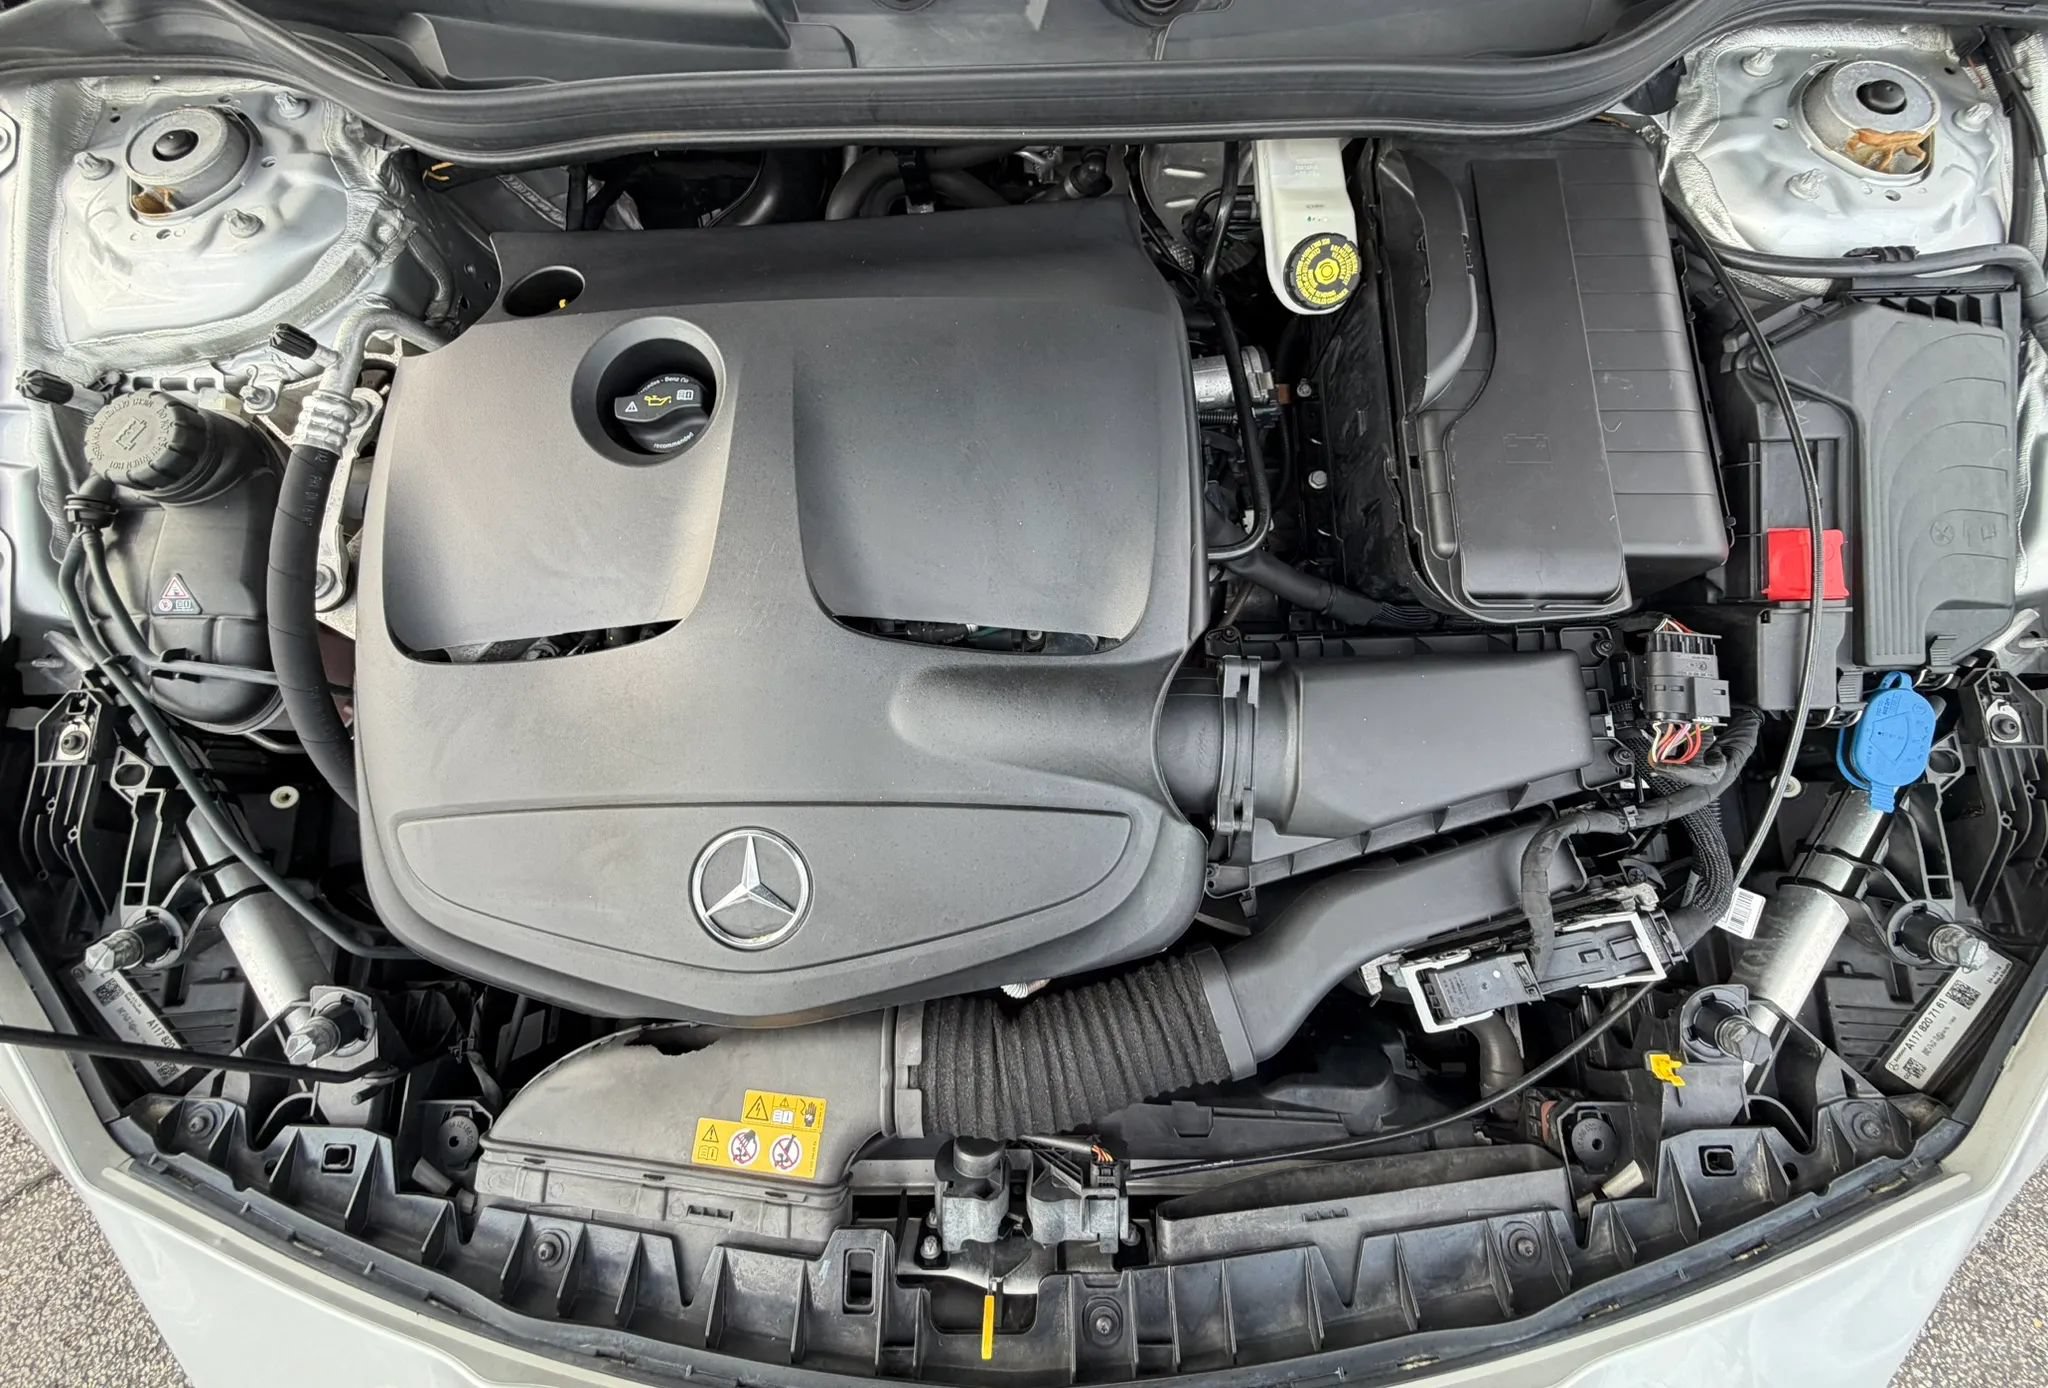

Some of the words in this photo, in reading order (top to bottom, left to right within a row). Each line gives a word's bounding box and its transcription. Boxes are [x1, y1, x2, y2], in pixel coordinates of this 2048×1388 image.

[653, 431, 694, 448] recommended
[146, 1019, 165, 1038] A117
[1905, 1030, 1923, 1051] A117
[1921, 1016, 1934, 1033] 820
[1931, 1007, 1942, 1019] 71
[1937, 998, 1948, 1010] 61
